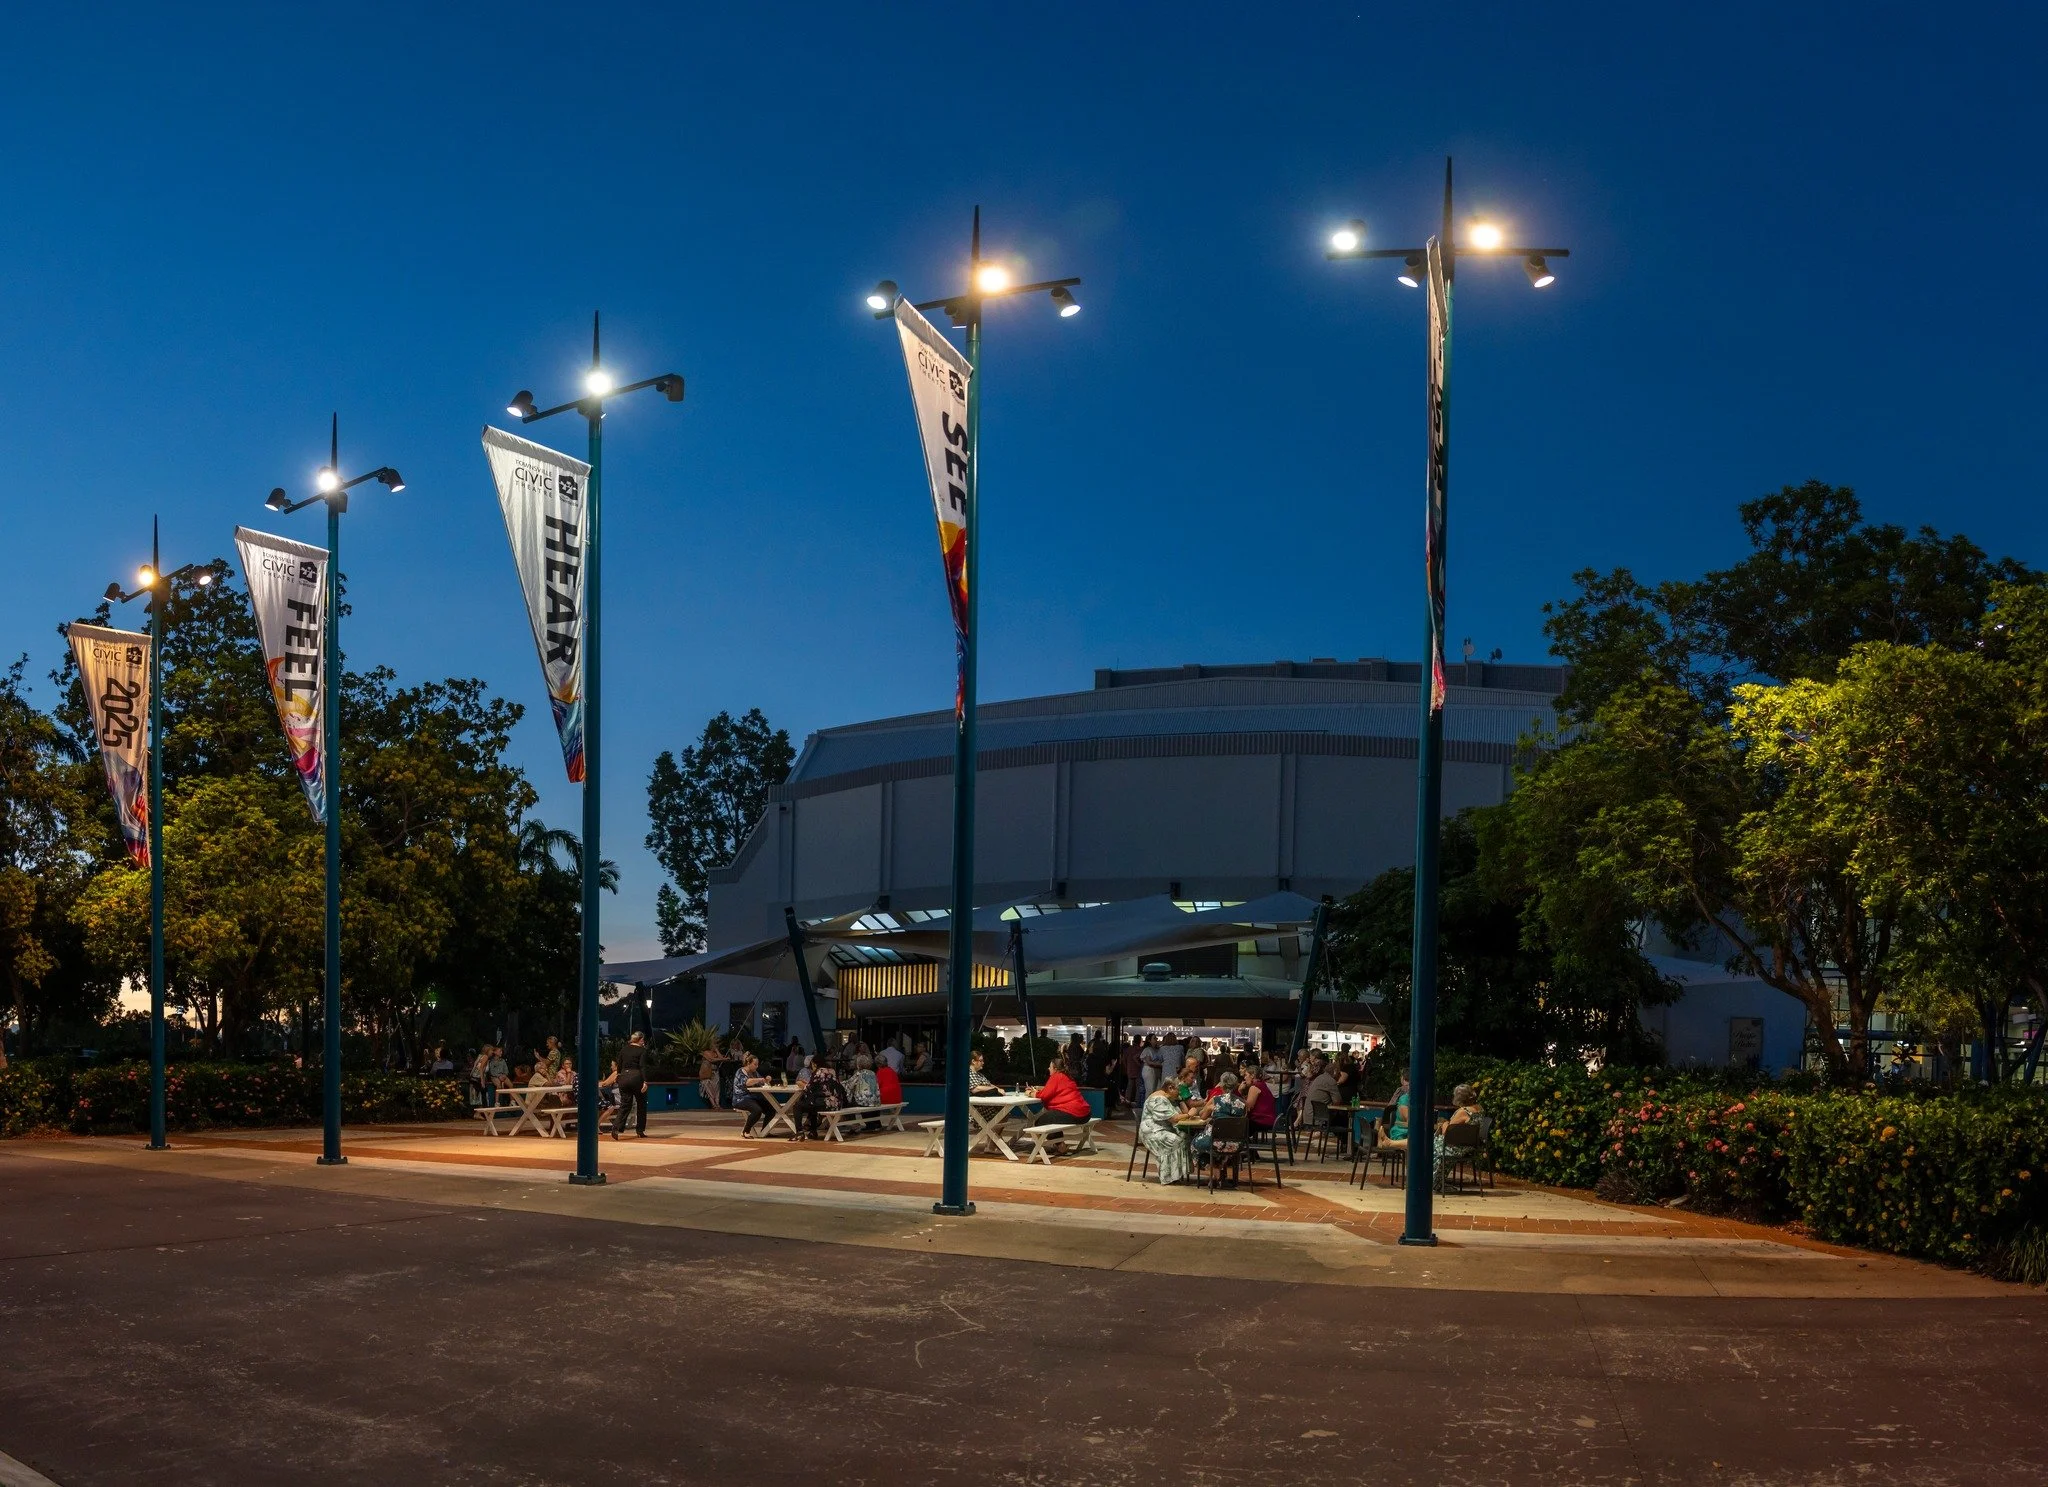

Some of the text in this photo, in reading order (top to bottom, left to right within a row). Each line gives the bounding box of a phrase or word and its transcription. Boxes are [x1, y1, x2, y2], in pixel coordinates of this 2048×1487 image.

[918, 351, 945, 384] CIVIC
[942, 411, 967, 516] SEE
[515, 467, 552, 490] CIVIC
[516, 480, 553, 498] THEATRE
[262, 558, 295, 577] CIVIC
[263, 570, 295, 583] THEATRE
[546, 515, 579, 665] HEAR
[93, 648, 121, 661] CIVIC
[285, 599, 318, 701] FEEL
[101, 677, 141, 749] 2025
